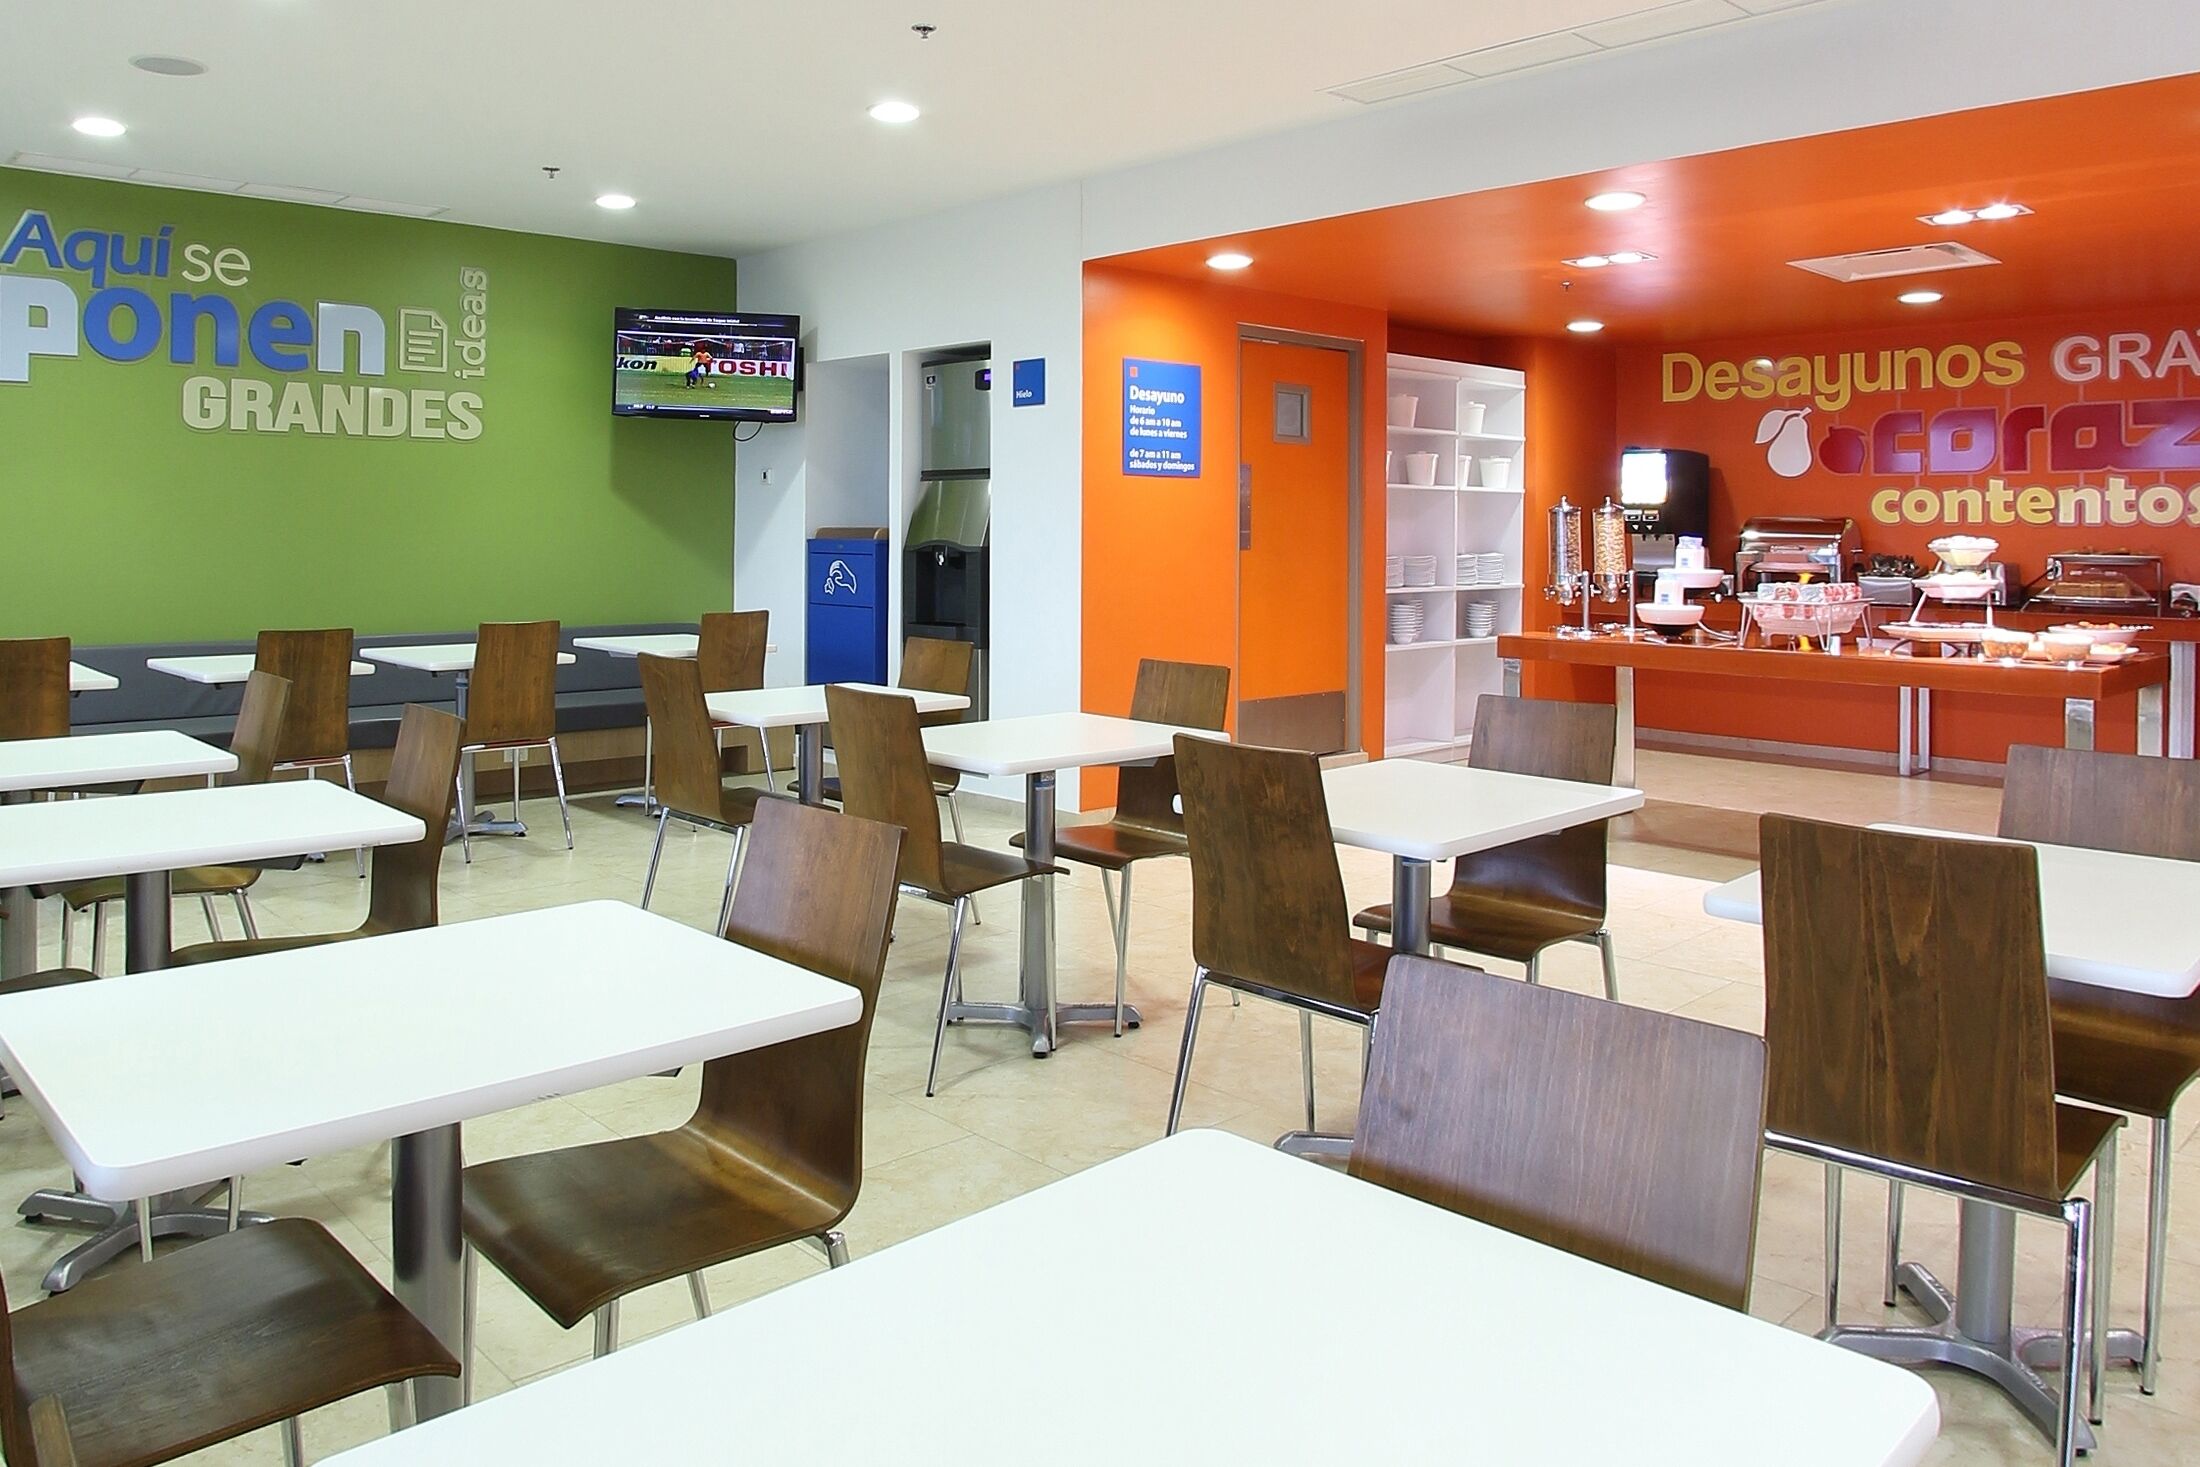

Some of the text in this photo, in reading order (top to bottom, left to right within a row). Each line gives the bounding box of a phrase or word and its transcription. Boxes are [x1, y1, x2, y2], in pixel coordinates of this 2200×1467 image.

[0, 209, 251, 289] Aquí se
[454, 266, 487, 380] ideas
[616, 356, 658, 370] kon
[1662, 328, 2200, 411] Desayunos GRA
[1015, 389, 1033, 399] Hielo
[1129, 385, 1185, 406] Desayuno
[182, 376, 485, 441] GRANDES
[1129, 404, 1156, 416] Horario
[1129, 416, 1139, 425] de
[1139, 416, 1145, 426] 6
[1145, 418, 1156, 426] am
[1170, 419, 1182, 428] am
[1129, 426, 1139, 436] de
[1139, 427, 1158, 437] lunes
[1163, 429, 1188, 439] viernes
[1129, 448, 1139, 458] de
[1139, 448, 1145, 458] 7
[1145, 450, 1156, 459] am
[1170, 451, 1182, 459] am
[1129, 459, 1158, 470] sábados
[1163, 461, 1195, 472] domingos
